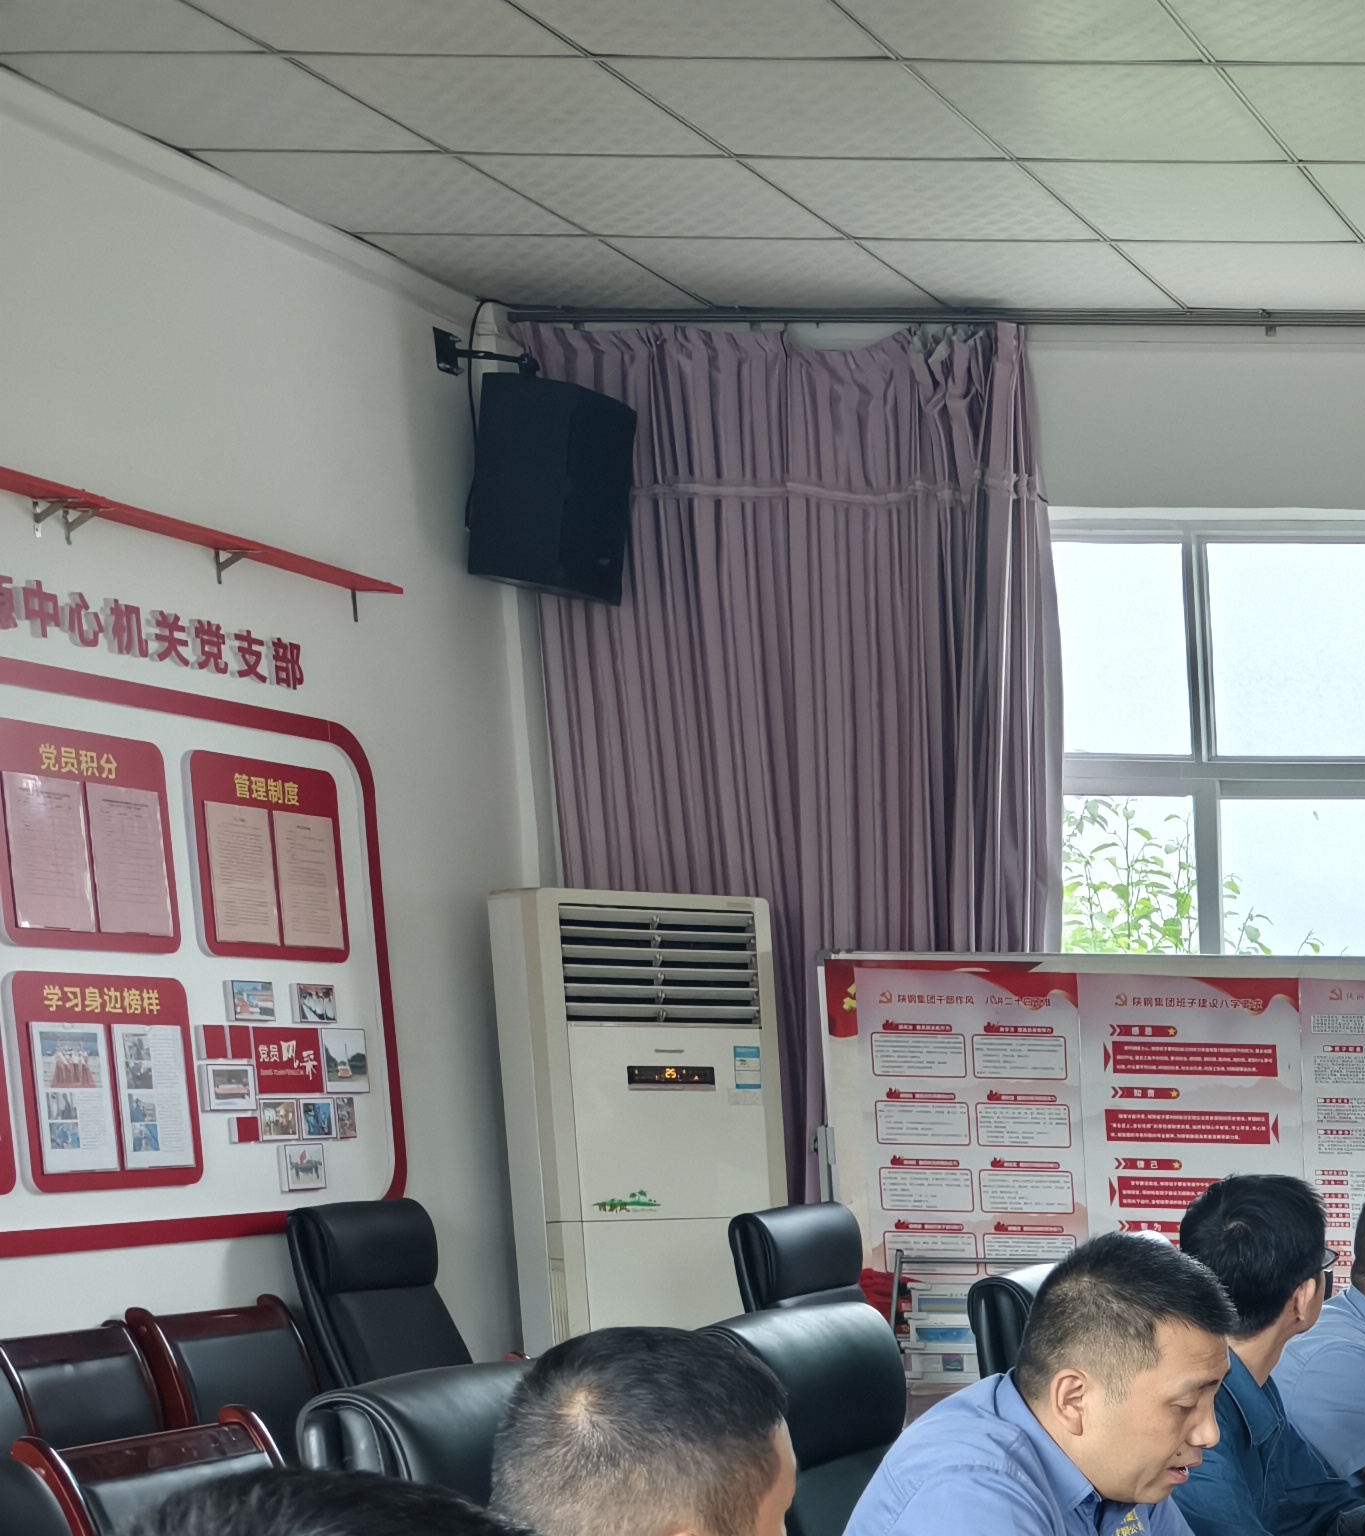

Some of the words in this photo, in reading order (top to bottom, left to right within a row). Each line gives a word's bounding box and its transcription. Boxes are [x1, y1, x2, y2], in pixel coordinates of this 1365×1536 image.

[39, 743, 118, 780] 党员积分
[233, 772, 300, 807] 管理制度
[43, 984, 161, 1015] 学习身边榜样
[258, 1040, 319, 1081] 党员风采
